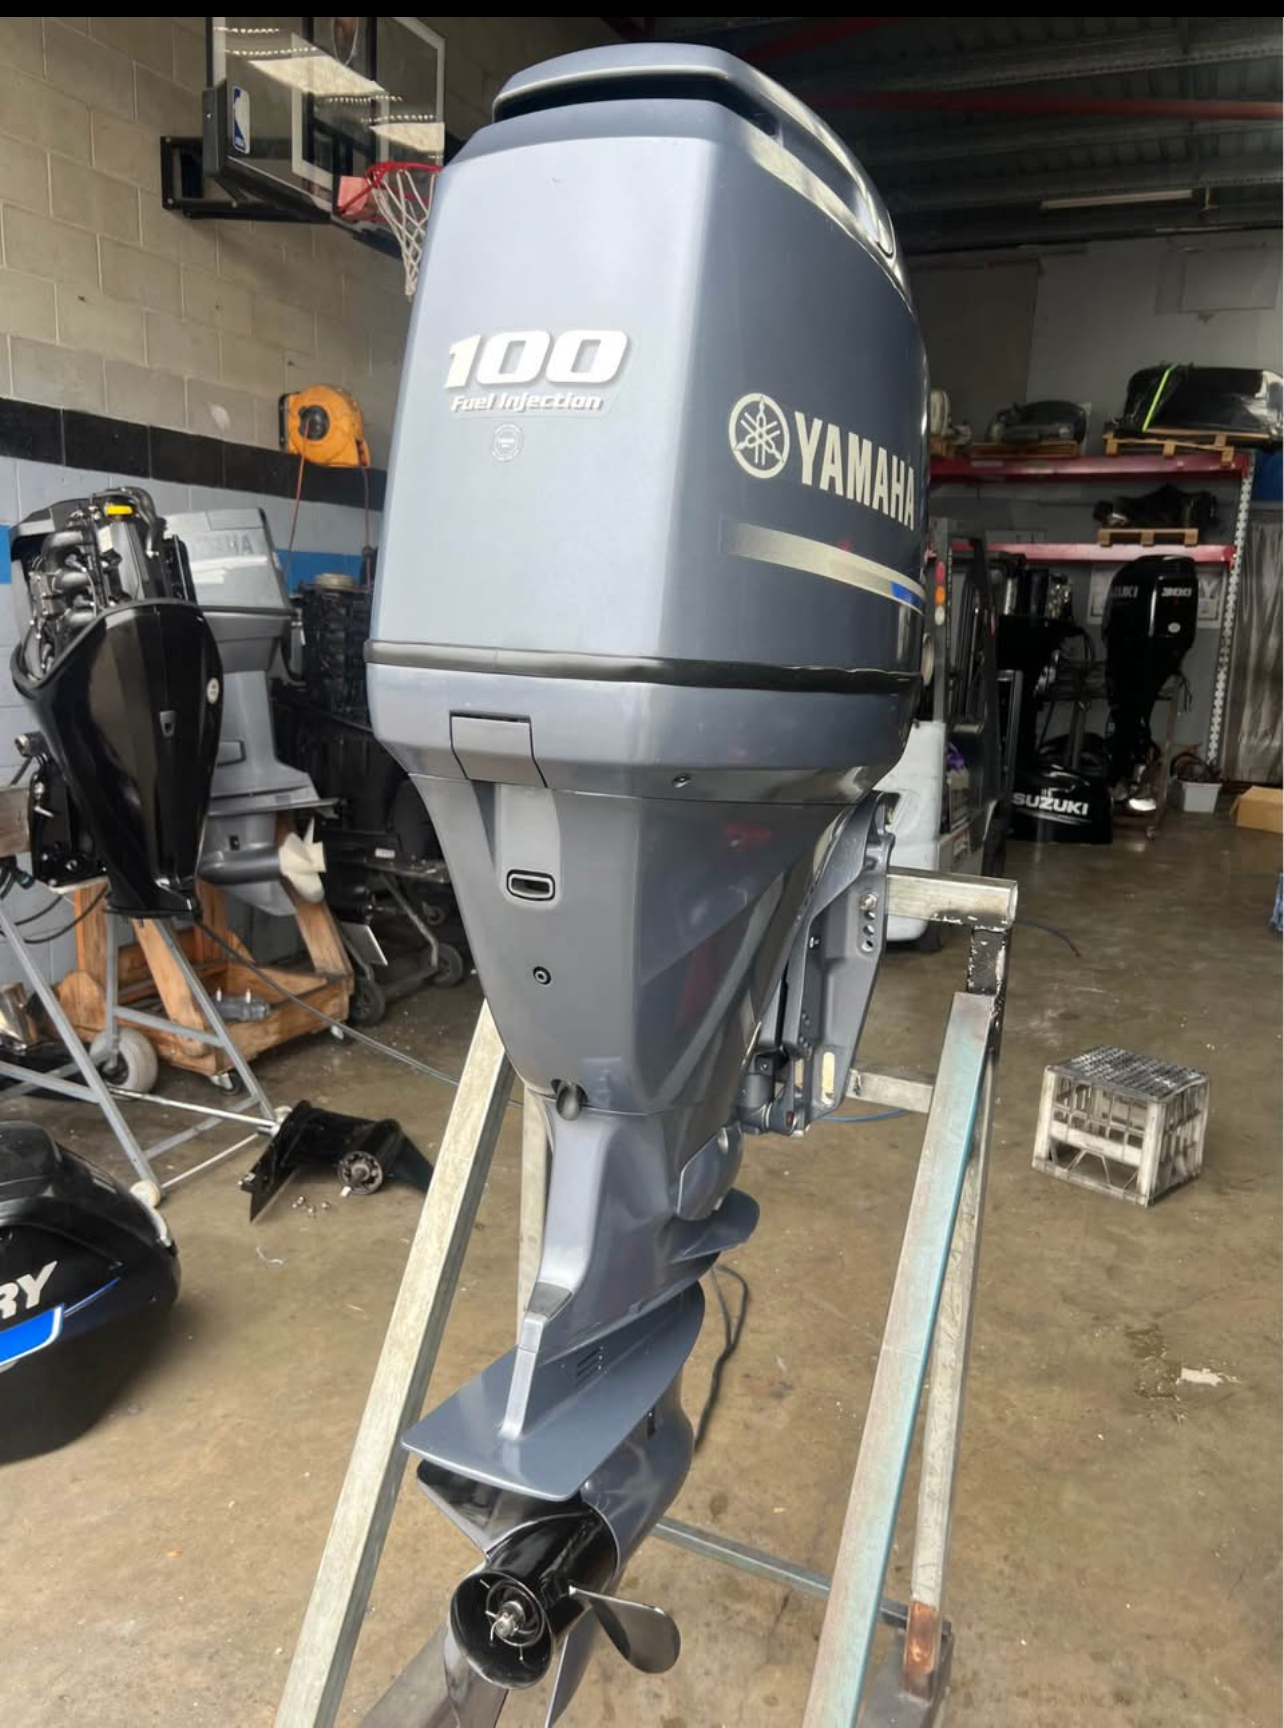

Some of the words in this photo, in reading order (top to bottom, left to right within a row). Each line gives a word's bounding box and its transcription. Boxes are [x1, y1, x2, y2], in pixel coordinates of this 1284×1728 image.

[444, 329, 629, 389] 100
[450, 393, 496, 412] Fuel
[498, 392, 604, 413] Injection
[794, 410, 915, 531] YAMAHA
[1011, 792, 1089, 817] SUZUKI
